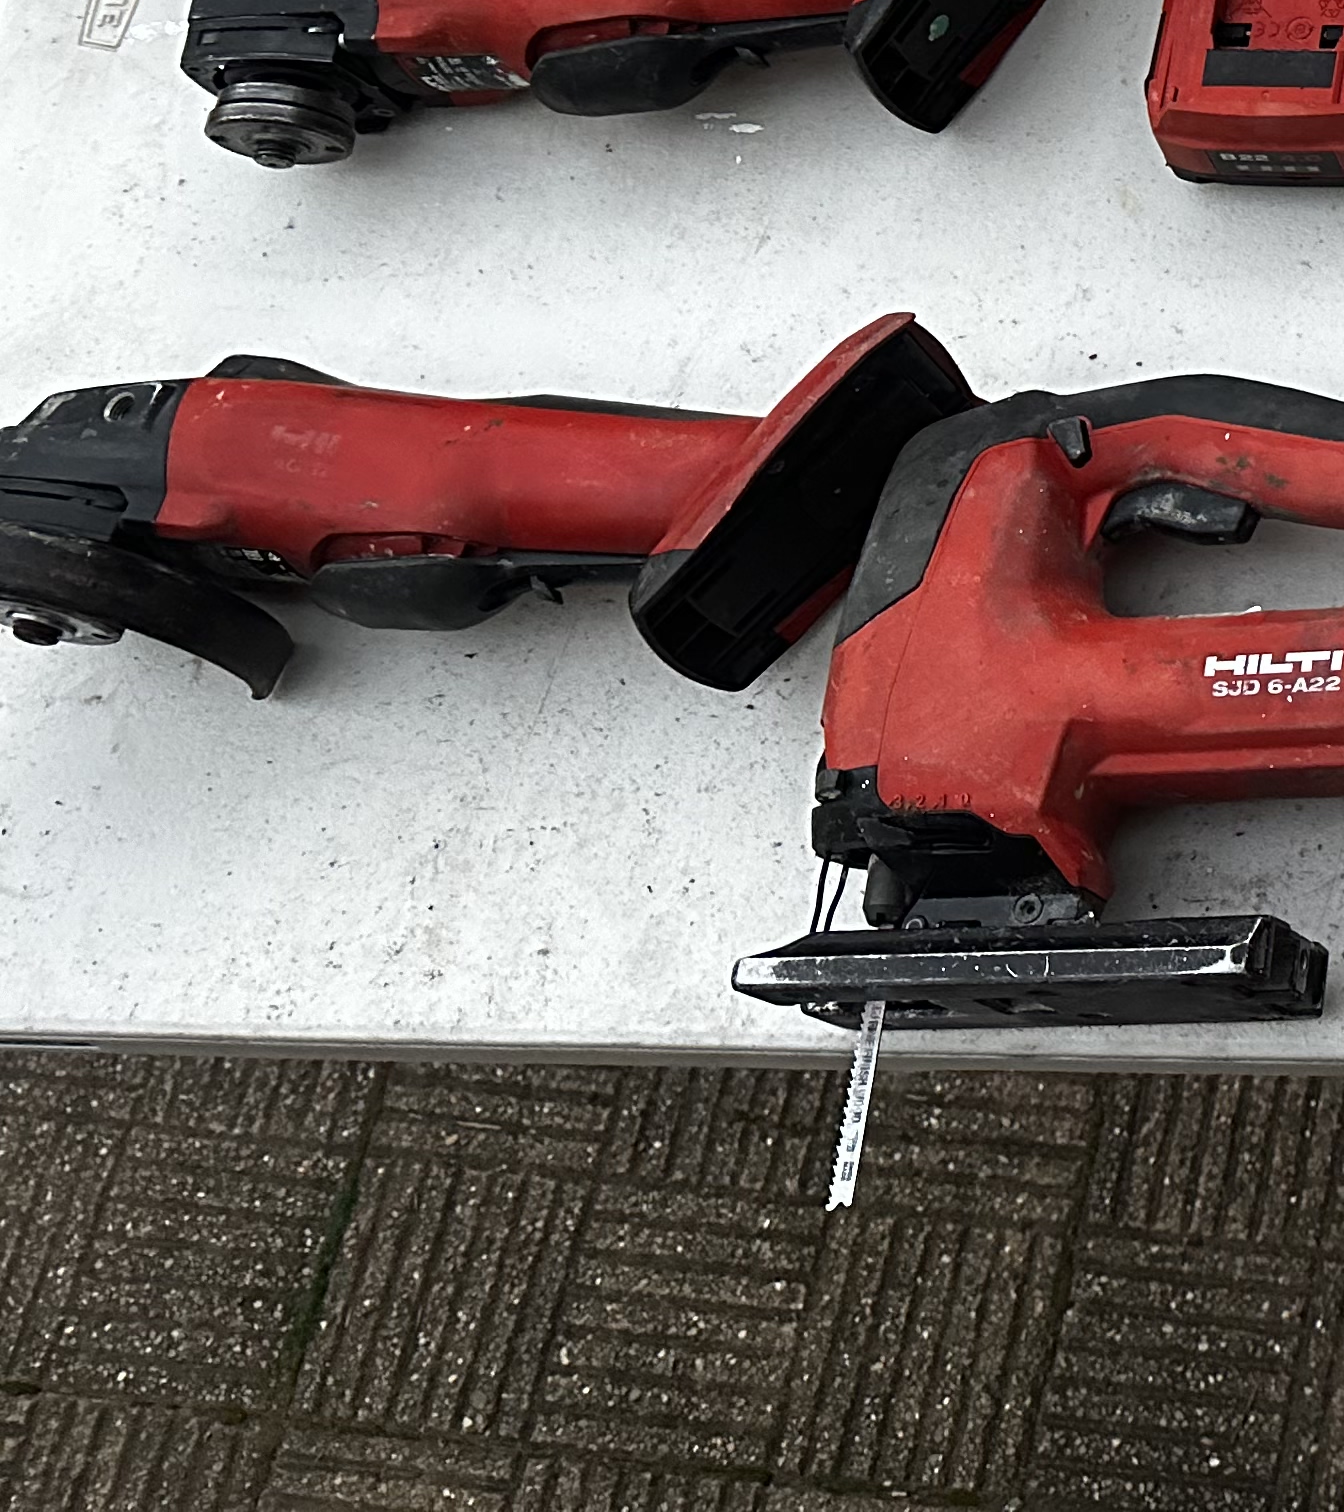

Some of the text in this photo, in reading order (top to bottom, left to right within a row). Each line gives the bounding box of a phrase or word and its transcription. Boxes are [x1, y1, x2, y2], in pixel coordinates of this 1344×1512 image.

[1203, 649, 1344, 677] HILTI
[1211, 675, 1341, 697] SJD 6-A22
